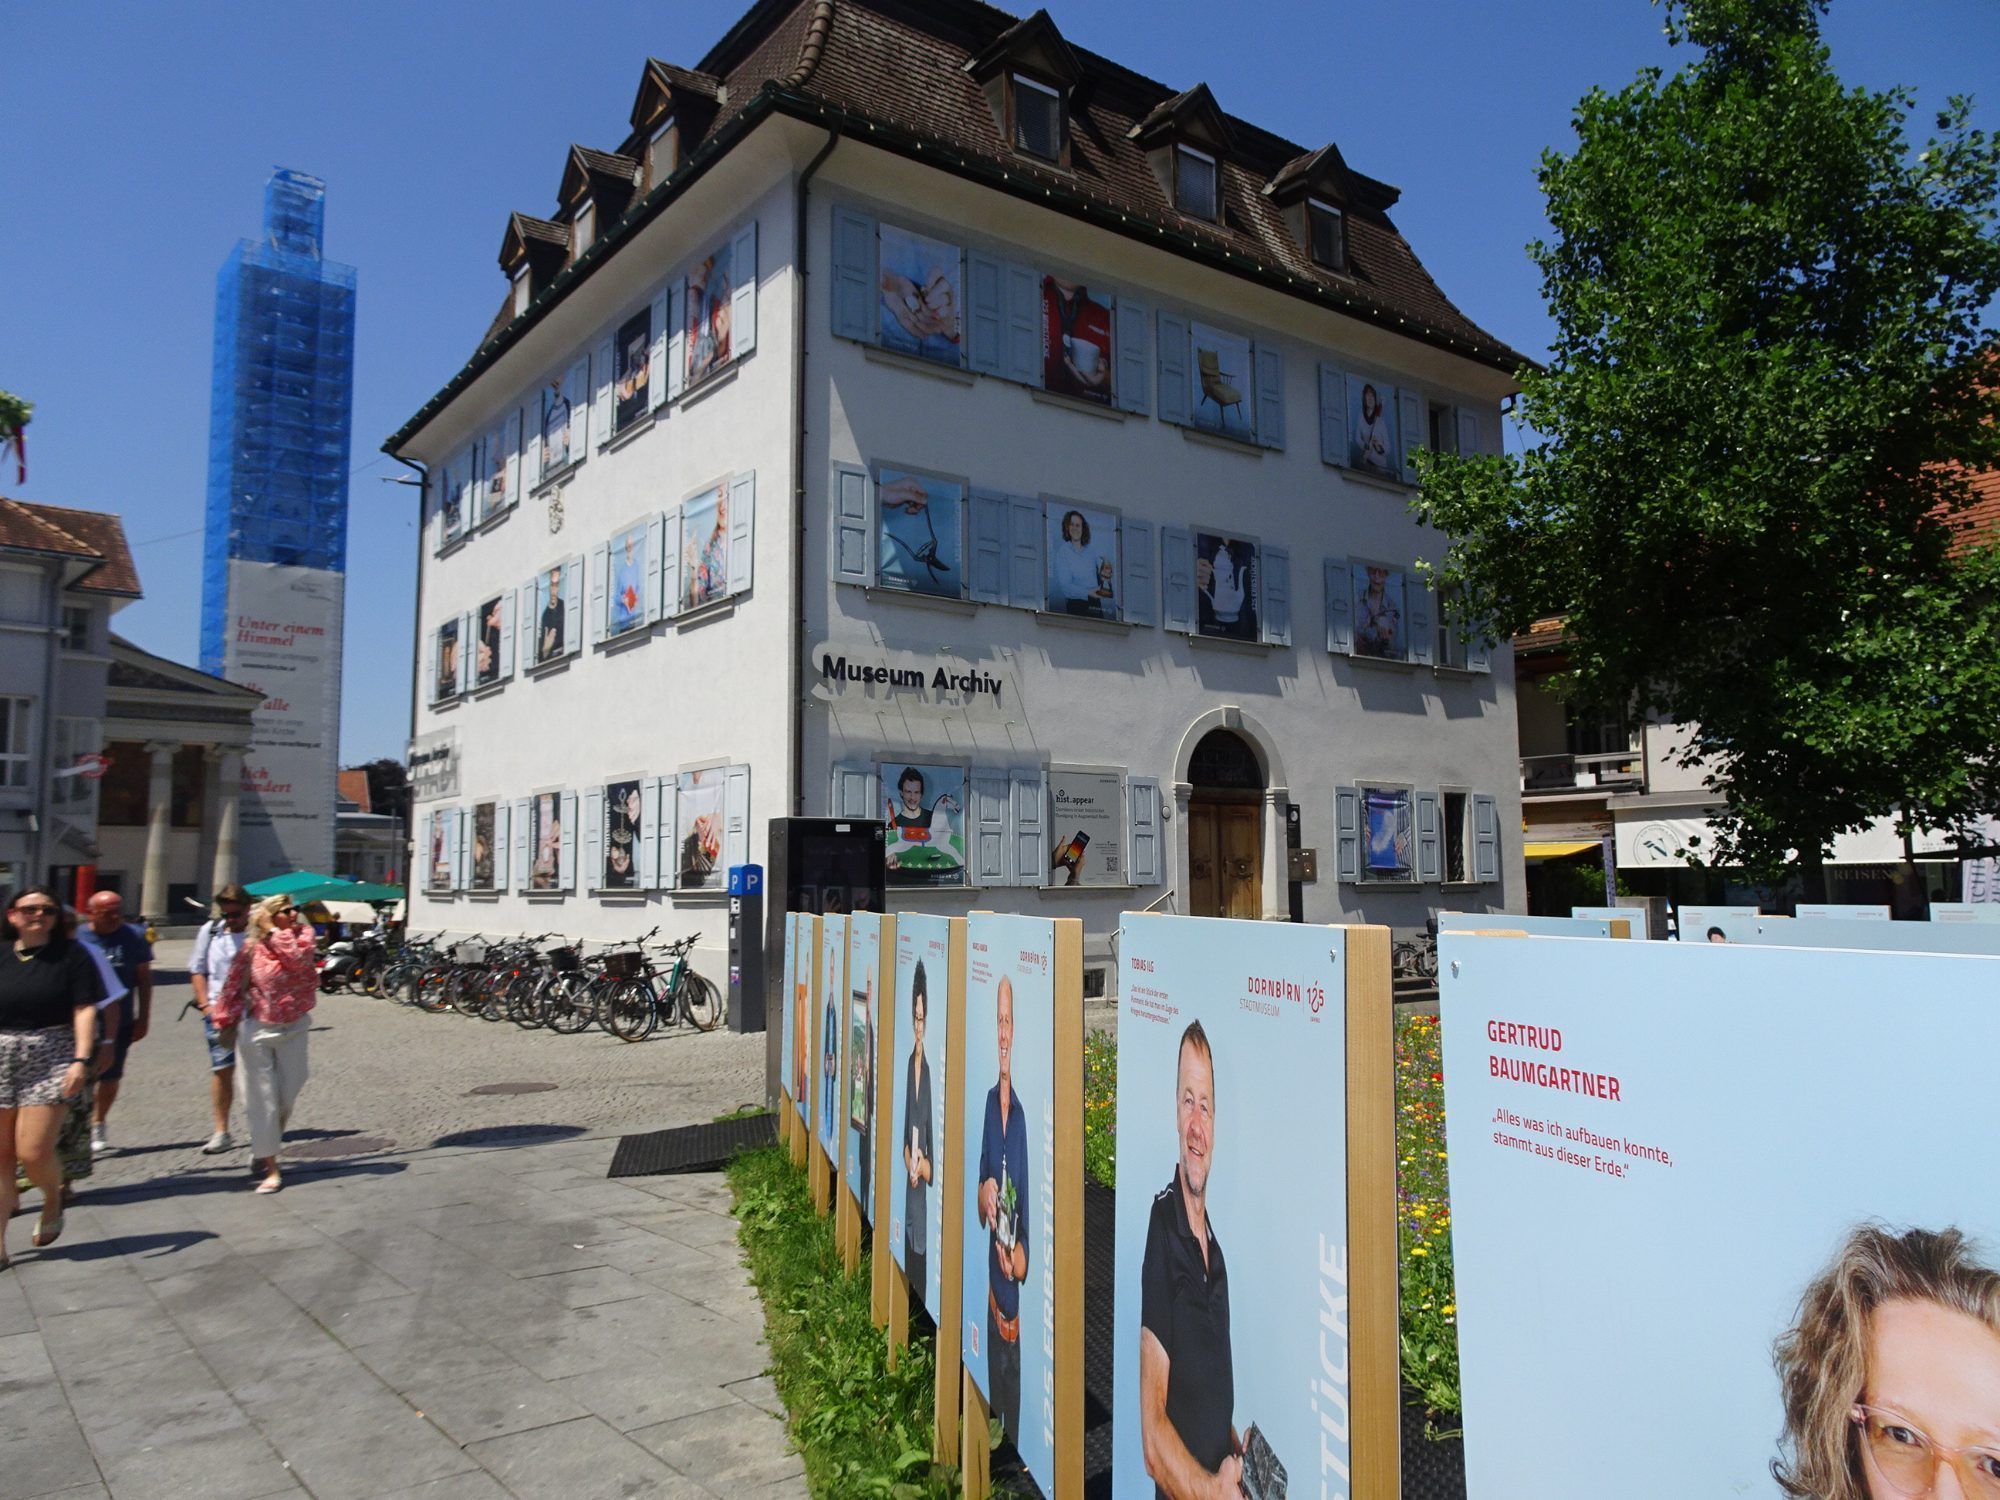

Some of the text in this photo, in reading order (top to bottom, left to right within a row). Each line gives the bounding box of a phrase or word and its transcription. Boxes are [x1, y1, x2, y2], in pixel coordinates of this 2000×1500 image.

[237, 615, 325, 636] Unter einem
[237, 629, 295, 647] Himmel
[822, 653, 1002, 695] Museum Archiv
[731, 874, 739, 890] P
[746, 874, 758, 890] P
[1833, 868, 1893, 880] REISEN
[1239, 998, 1280, 1017] STADTMUSEUM
[1248, 976, 1324, 1013] DORNBIRN 125
[1487, 1019, 1562, 1052] GERTRUD
[1489, 1055, 1621, 1102] BAUMGARTNER
[1492, 1107, 1674, 1168] „Alles was ich aufbauen konnte,
[1493, 1131, 1630, 1179] stammt aus dieser Erde.“
[1040, 1097, 1054, 1448] 125 ERBSTÜCKE
